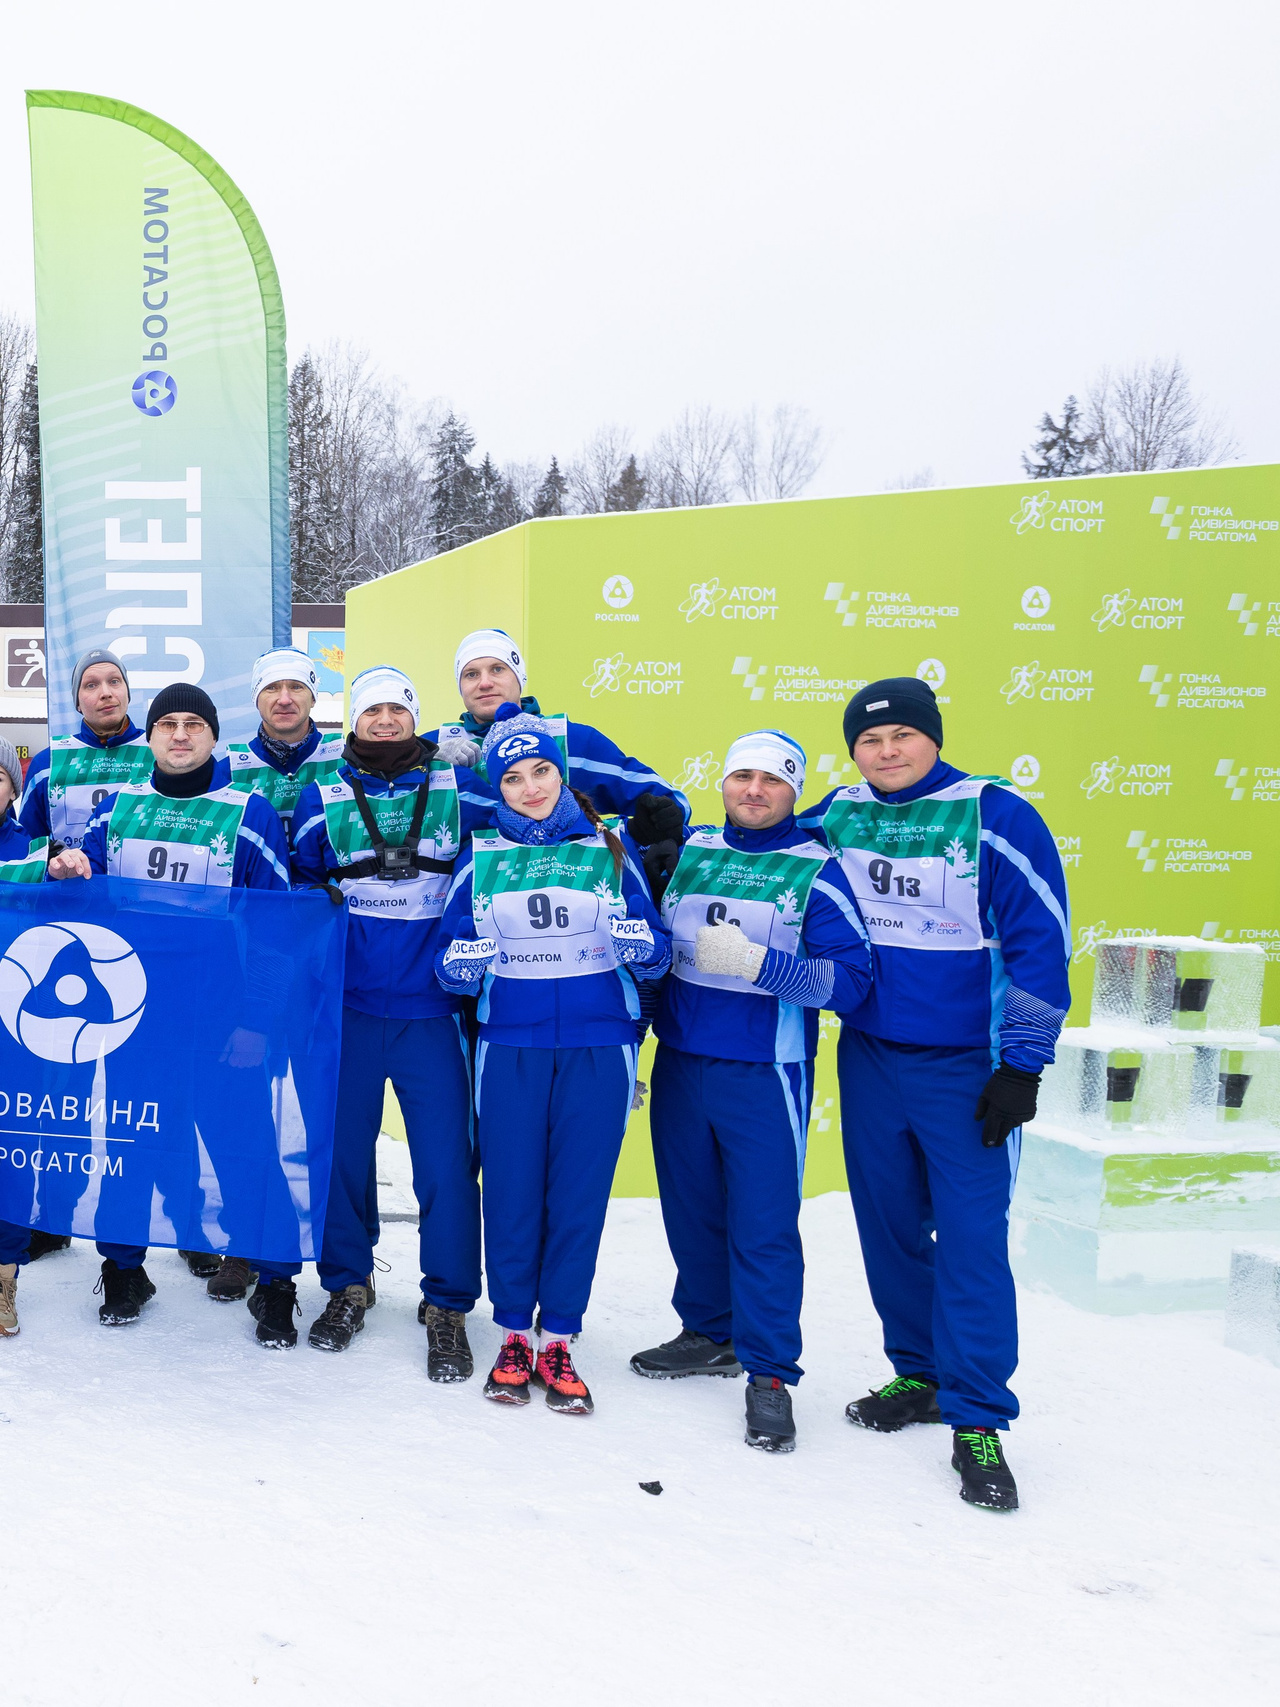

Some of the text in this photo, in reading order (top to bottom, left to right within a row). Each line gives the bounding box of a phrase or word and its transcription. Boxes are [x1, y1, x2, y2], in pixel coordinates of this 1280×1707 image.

[1058, 500, 1103, 514] АТОМ
[1190, 506, 1233, 517] ГОНКА
[1050, 518, 1105, 532] СПОРТ
[1189, 518, 1279, 531] ДИВИЗИОНОВ
[1189, 530, 1257, 542] РОСАТОМА
[728, 586, 776, 600] АТОМ
[867, 591, 911, 602] ГОНКА
[1138, 597, 1183, 611] АТОМ
[721, 605, 779, 620] СПОРТ
[866, 604, 959, 617] ДИВИЗИОНОВ
[595, 613, 639, 622] РОСАТОМ
[865, 617, 937, 628] РОСАТОМА
[1131, 615, 1185, 629] СПОРТ
[1013, 622, 1055, 631] РОСАТОМ
[633, 661, 681, 676] АТОМ
[774, 665, 819, 676] ГОНКА
[1047, 669, 1092, 683] АТОМ
[1179, 674, 1220, 683] ГОНКА
[626, 680, 684, 694] СПОРТ
[774, 678, 868, 690] ДИВИЗИОНОВ
[773, 691, 845, 702] РОСАТОМА
[1040, 687, 1095, 702] СПОРТ
[1178, 685, 1266, 697] ДИВИЗИОНОВ
[1177, 698, 1245, 709] РОСАТОМА
[503, 750, 540, 765] РОСАТОМ
[1127, 764, 1170, 778] АТОМ
[1254, 767, 1280, 777] ГОН
[1119, 782, 1172, 796] СПОРТ
[1021, 791, 1044, 799] АТОМ
[156, 808, 183, 816] ГОНКА
[375, 810, 405, 819] ГОНКА
[153, 821, 197, 831] РОСАТОМА
[154, 815, 214, 827] ДИВИЗИОНОВ
[379, 825, 410, 834] РОСАТО
[877, 825, 944, 835] ДИВИЗИОНОВ
[875, 834, 926, 843] РОСАТОМА
[1166, 839, 1207, 848] ГОНКА
[526, 855, 558, 867] ГОНКА
[1165, 851, 1252, 861] ДИВИЗИОНОВ
[526, 863, 594, 873] ДИВИЗИОНОВ
[722, 863, 753, 873] ГОНКА
[1164, 863, 1230, 872] РОСАТОМА
[526, 868, 578, 879] РОСАТОМА
[720, 872, 785, 883] ДИВИЗИОНОВ
[716, 878, 766, 888] РОСАТОМА
[360, 898, 407, 908] РОСАТОМ
[865, 916, 903, 929] САТОМ
[510, 953, 562, 963] РОСАТОМ
